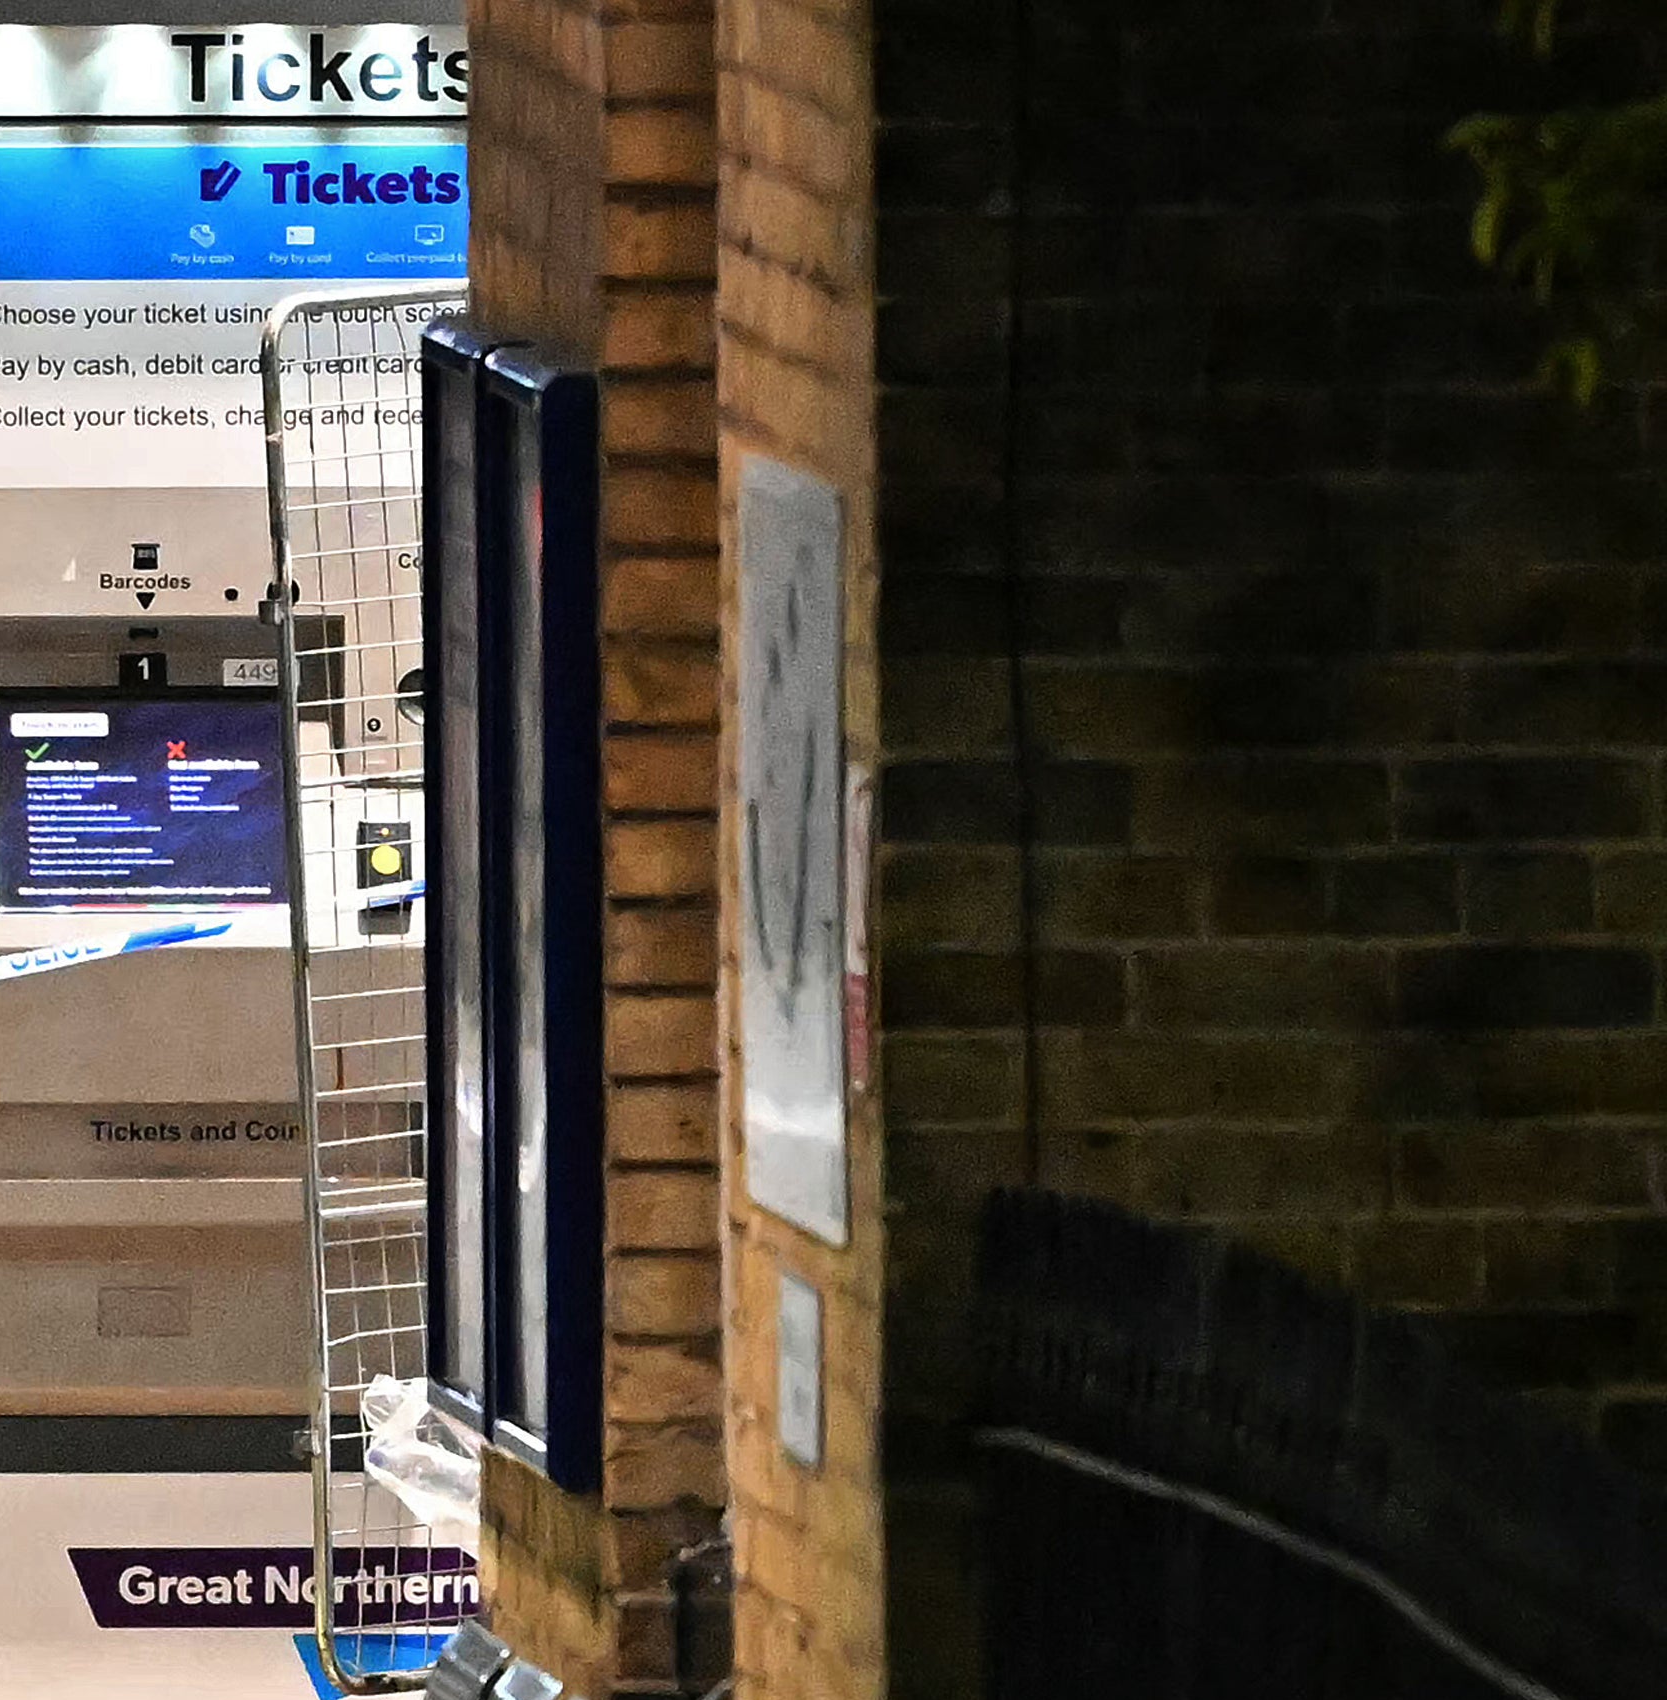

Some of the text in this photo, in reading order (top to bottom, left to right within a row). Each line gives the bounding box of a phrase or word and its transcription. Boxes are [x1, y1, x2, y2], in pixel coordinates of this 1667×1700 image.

[171, 34, 468, 102] Tickets
[263, 160, 461, 204] Tickets
[84, 307, 137, 329] your
[144, 303, 207, 324] ticket
[38, 355, 65, 380] by
[73, 355, 137, 377] cash,
[145, 354, 204, 375] debit
[74, 410, 126, 431] your
[134, 406, 216, 429] tickets,
[225, 405, 312, 431] chage
[321, 404, 364, 425] and
[99, 574, 191, 590] Barcodes
[138, 657, 150, 680] 1
[90, 1120, 182, 1142] Tickets
[190, 1121, 237, 1142] and
[118, 1565, 253, 1605] Great
